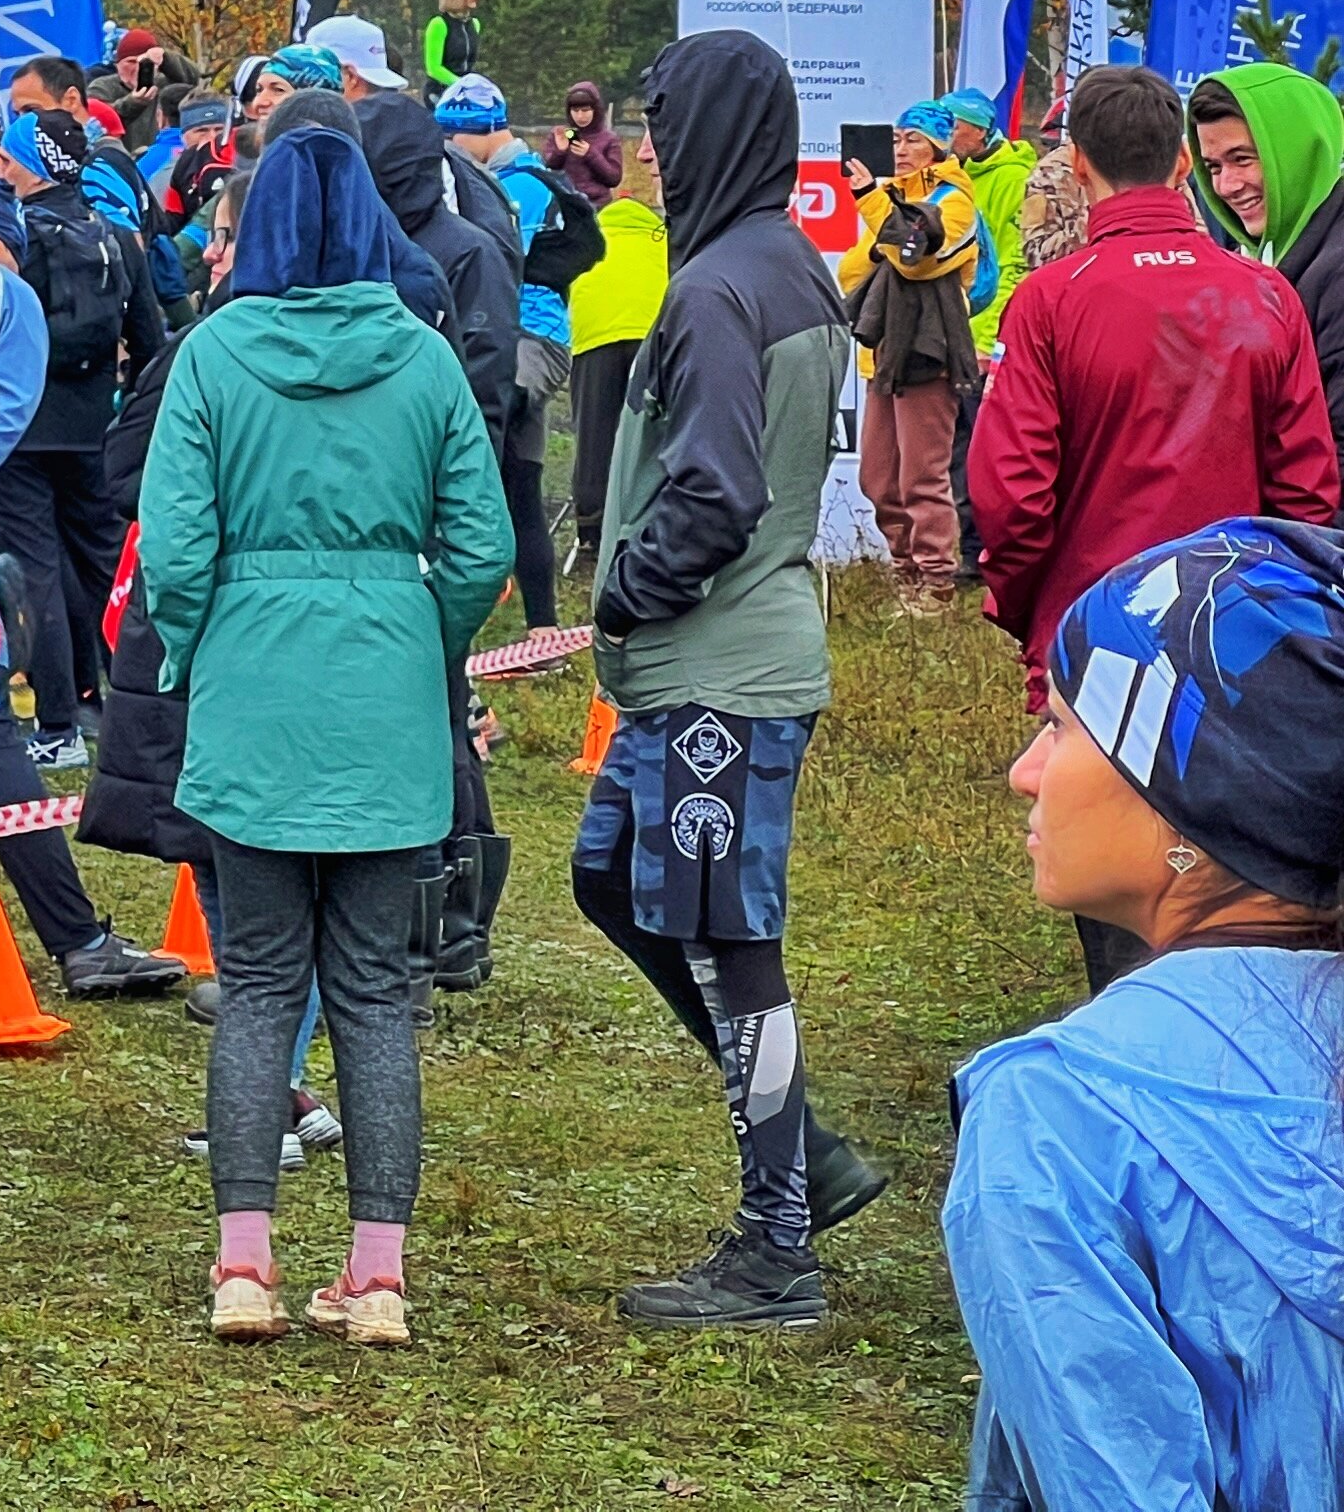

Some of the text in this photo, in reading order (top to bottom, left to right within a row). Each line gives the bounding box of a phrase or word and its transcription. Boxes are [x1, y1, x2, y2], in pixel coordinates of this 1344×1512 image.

[706, 1, 863, 15] РОССИЙСКОЙ ФЕДЕРАЦИИ
[791, 59, 861, 71] едерация
[798, 92, 833, 101] ссии
[1133, 250, 1197, 268] RUS
